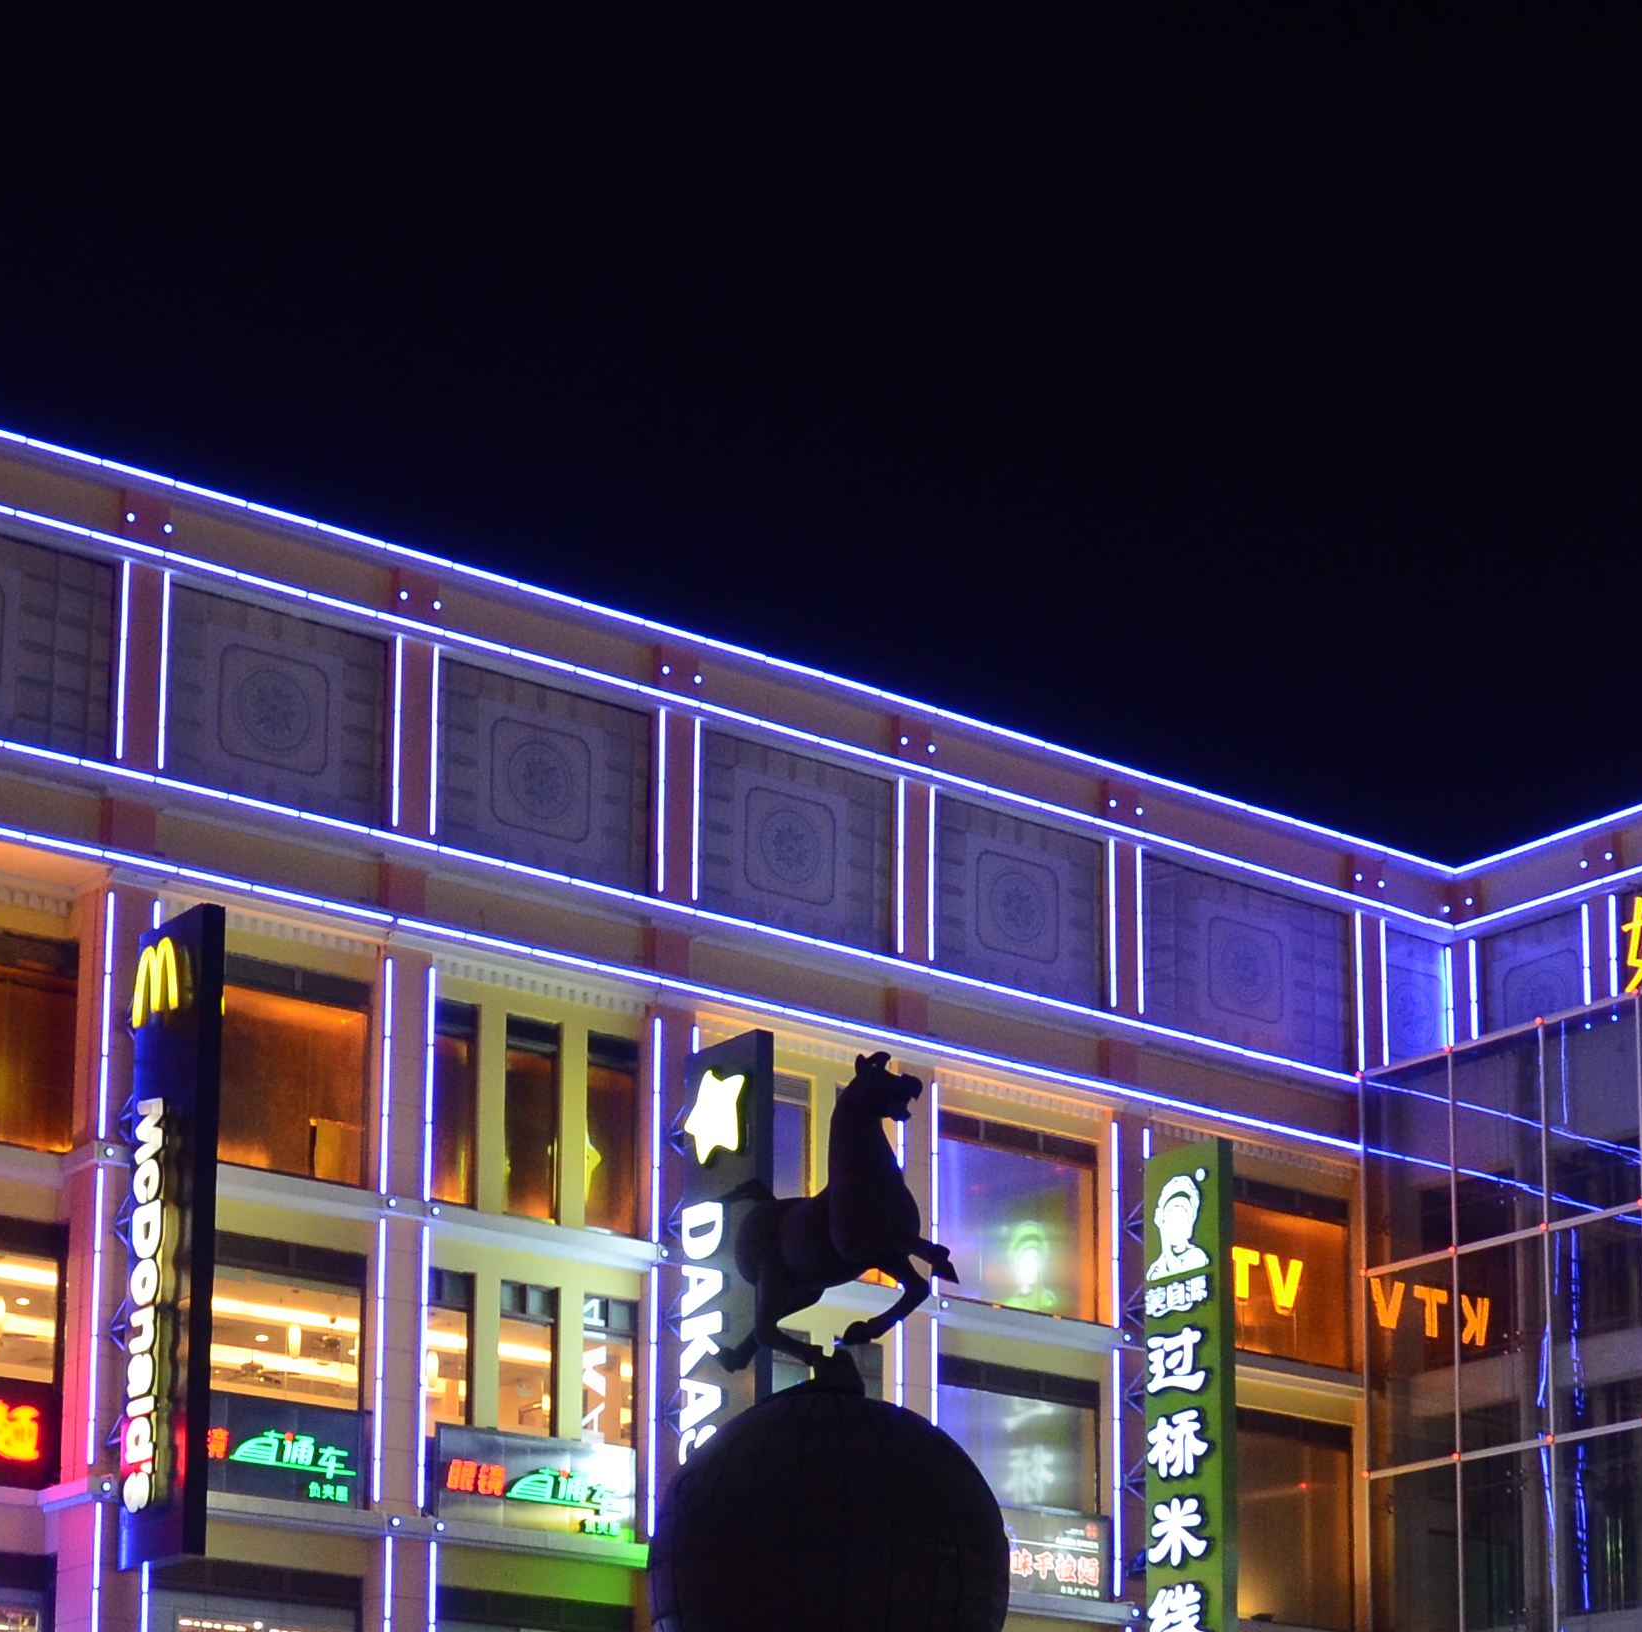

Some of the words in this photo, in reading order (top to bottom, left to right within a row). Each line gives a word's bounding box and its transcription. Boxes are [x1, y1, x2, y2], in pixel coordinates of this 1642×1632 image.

[124, 1097, 165, 1514] McDonald's
[230, 1429, 356, 1479] 直通车
[446, 1458, 507, 1497] 眼镜
